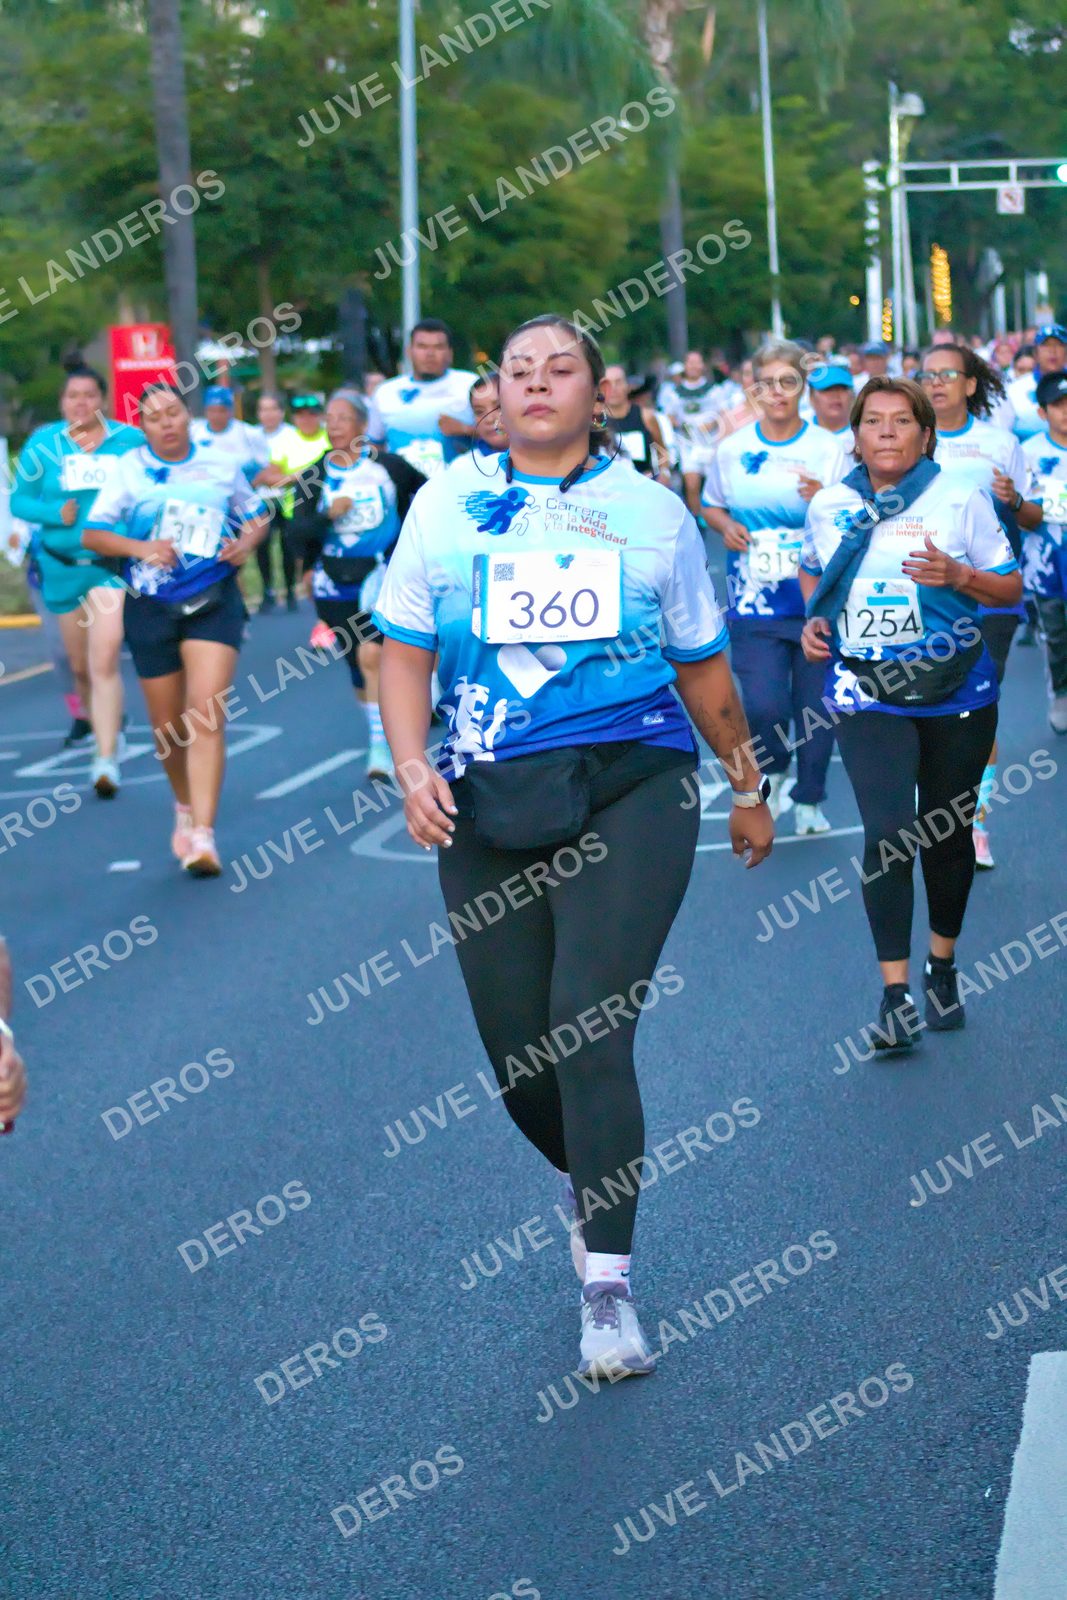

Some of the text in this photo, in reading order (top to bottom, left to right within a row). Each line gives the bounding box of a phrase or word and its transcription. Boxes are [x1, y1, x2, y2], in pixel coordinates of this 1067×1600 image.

[546, 497, 608, 521] Carrera
[545, 512, 608, 530] por la Vida
[566, 523, 628, 545] Integridad
[896, 529, 938, 538] Integridad
[508, 588, 599, 629] 360
[841, 608, 920, 639] 1254
